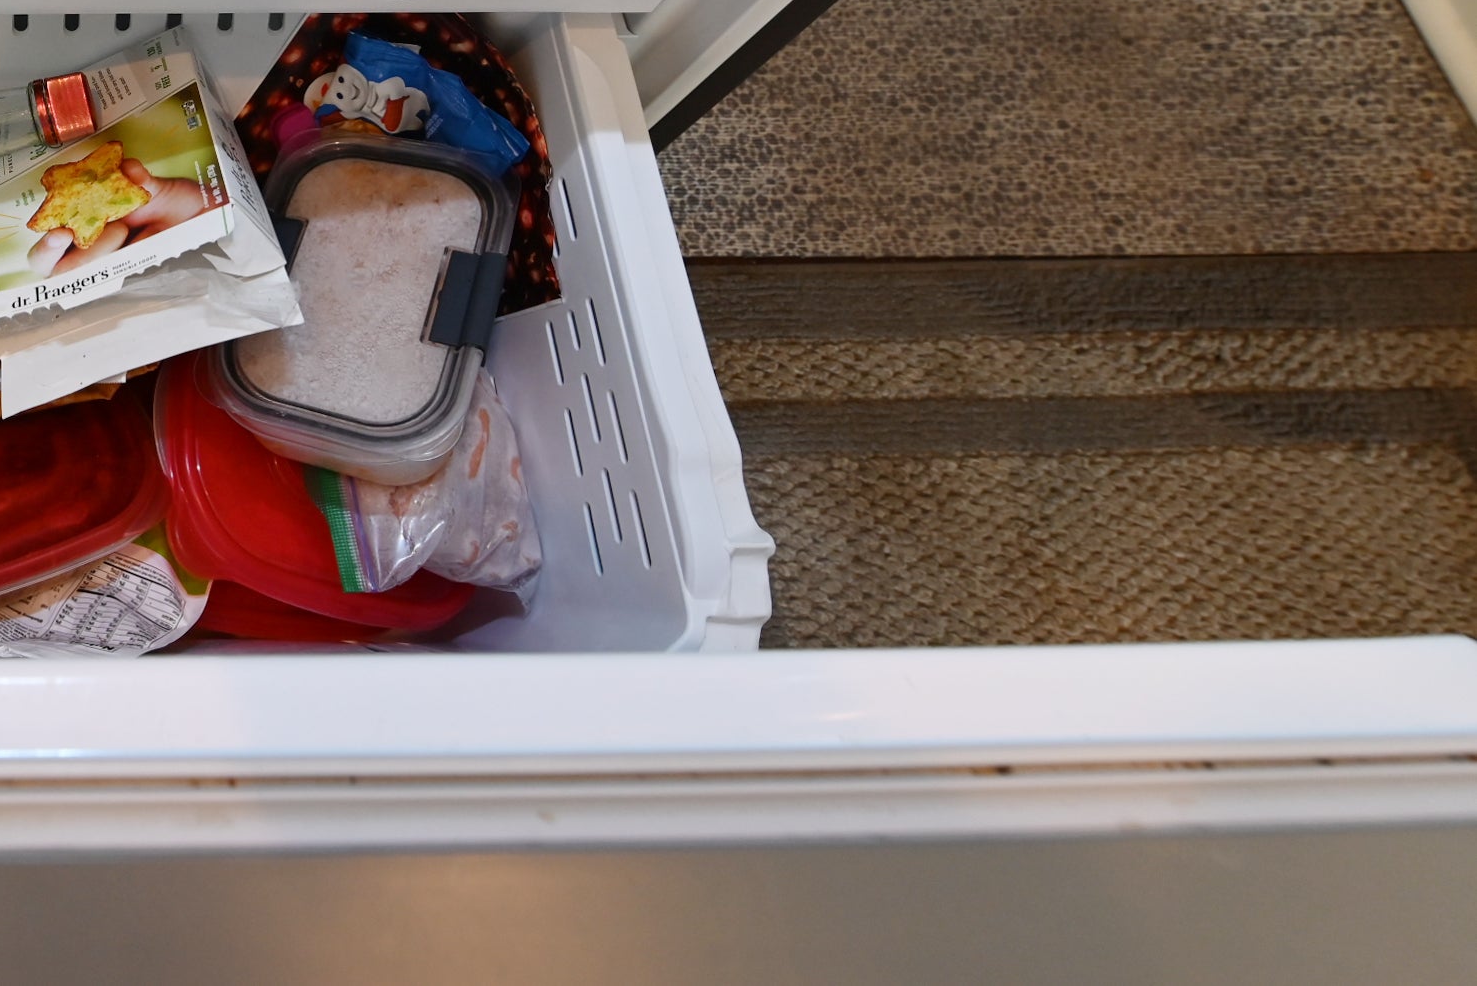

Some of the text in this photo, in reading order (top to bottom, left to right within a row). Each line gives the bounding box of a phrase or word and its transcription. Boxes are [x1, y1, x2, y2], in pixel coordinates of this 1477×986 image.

[161, 75, 171, 89] FREE
[11, 267, 110, 310] dr. Praeger's
